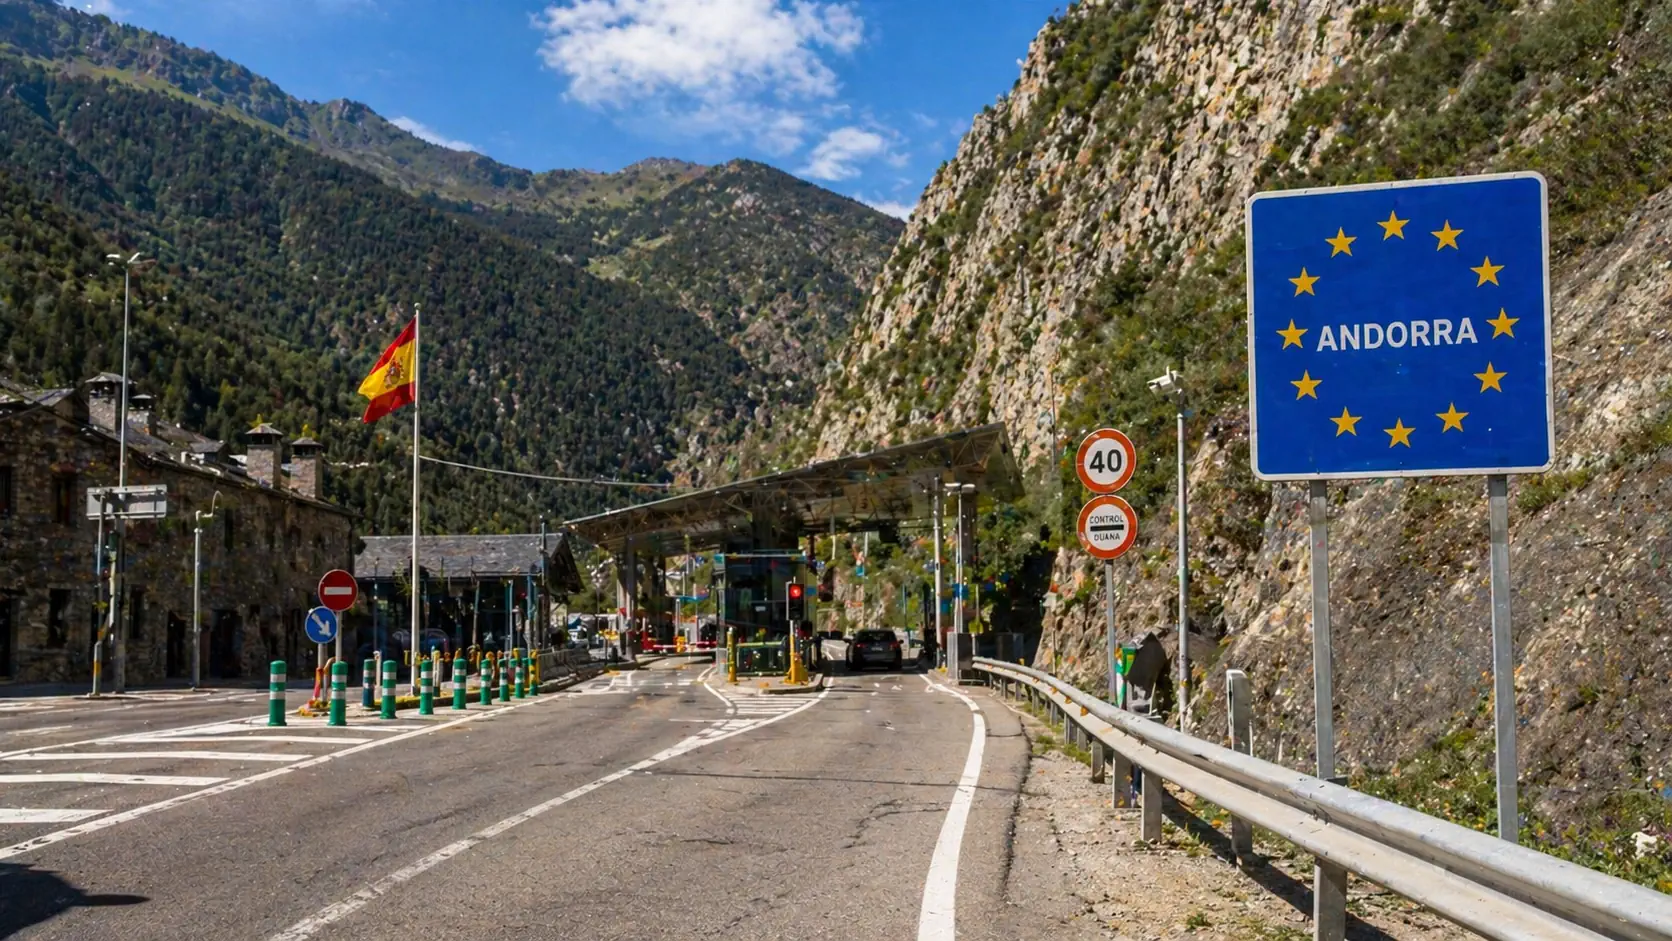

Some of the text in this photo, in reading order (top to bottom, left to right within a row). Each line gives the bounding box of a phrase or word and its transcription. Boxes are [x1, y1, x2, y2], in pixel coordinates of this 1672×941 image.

[1316, 317, 1478, 352] ANDORRA
[1089, 449, 1122, 473] 40
[1089, 515, 1123, 524] CONTROL
